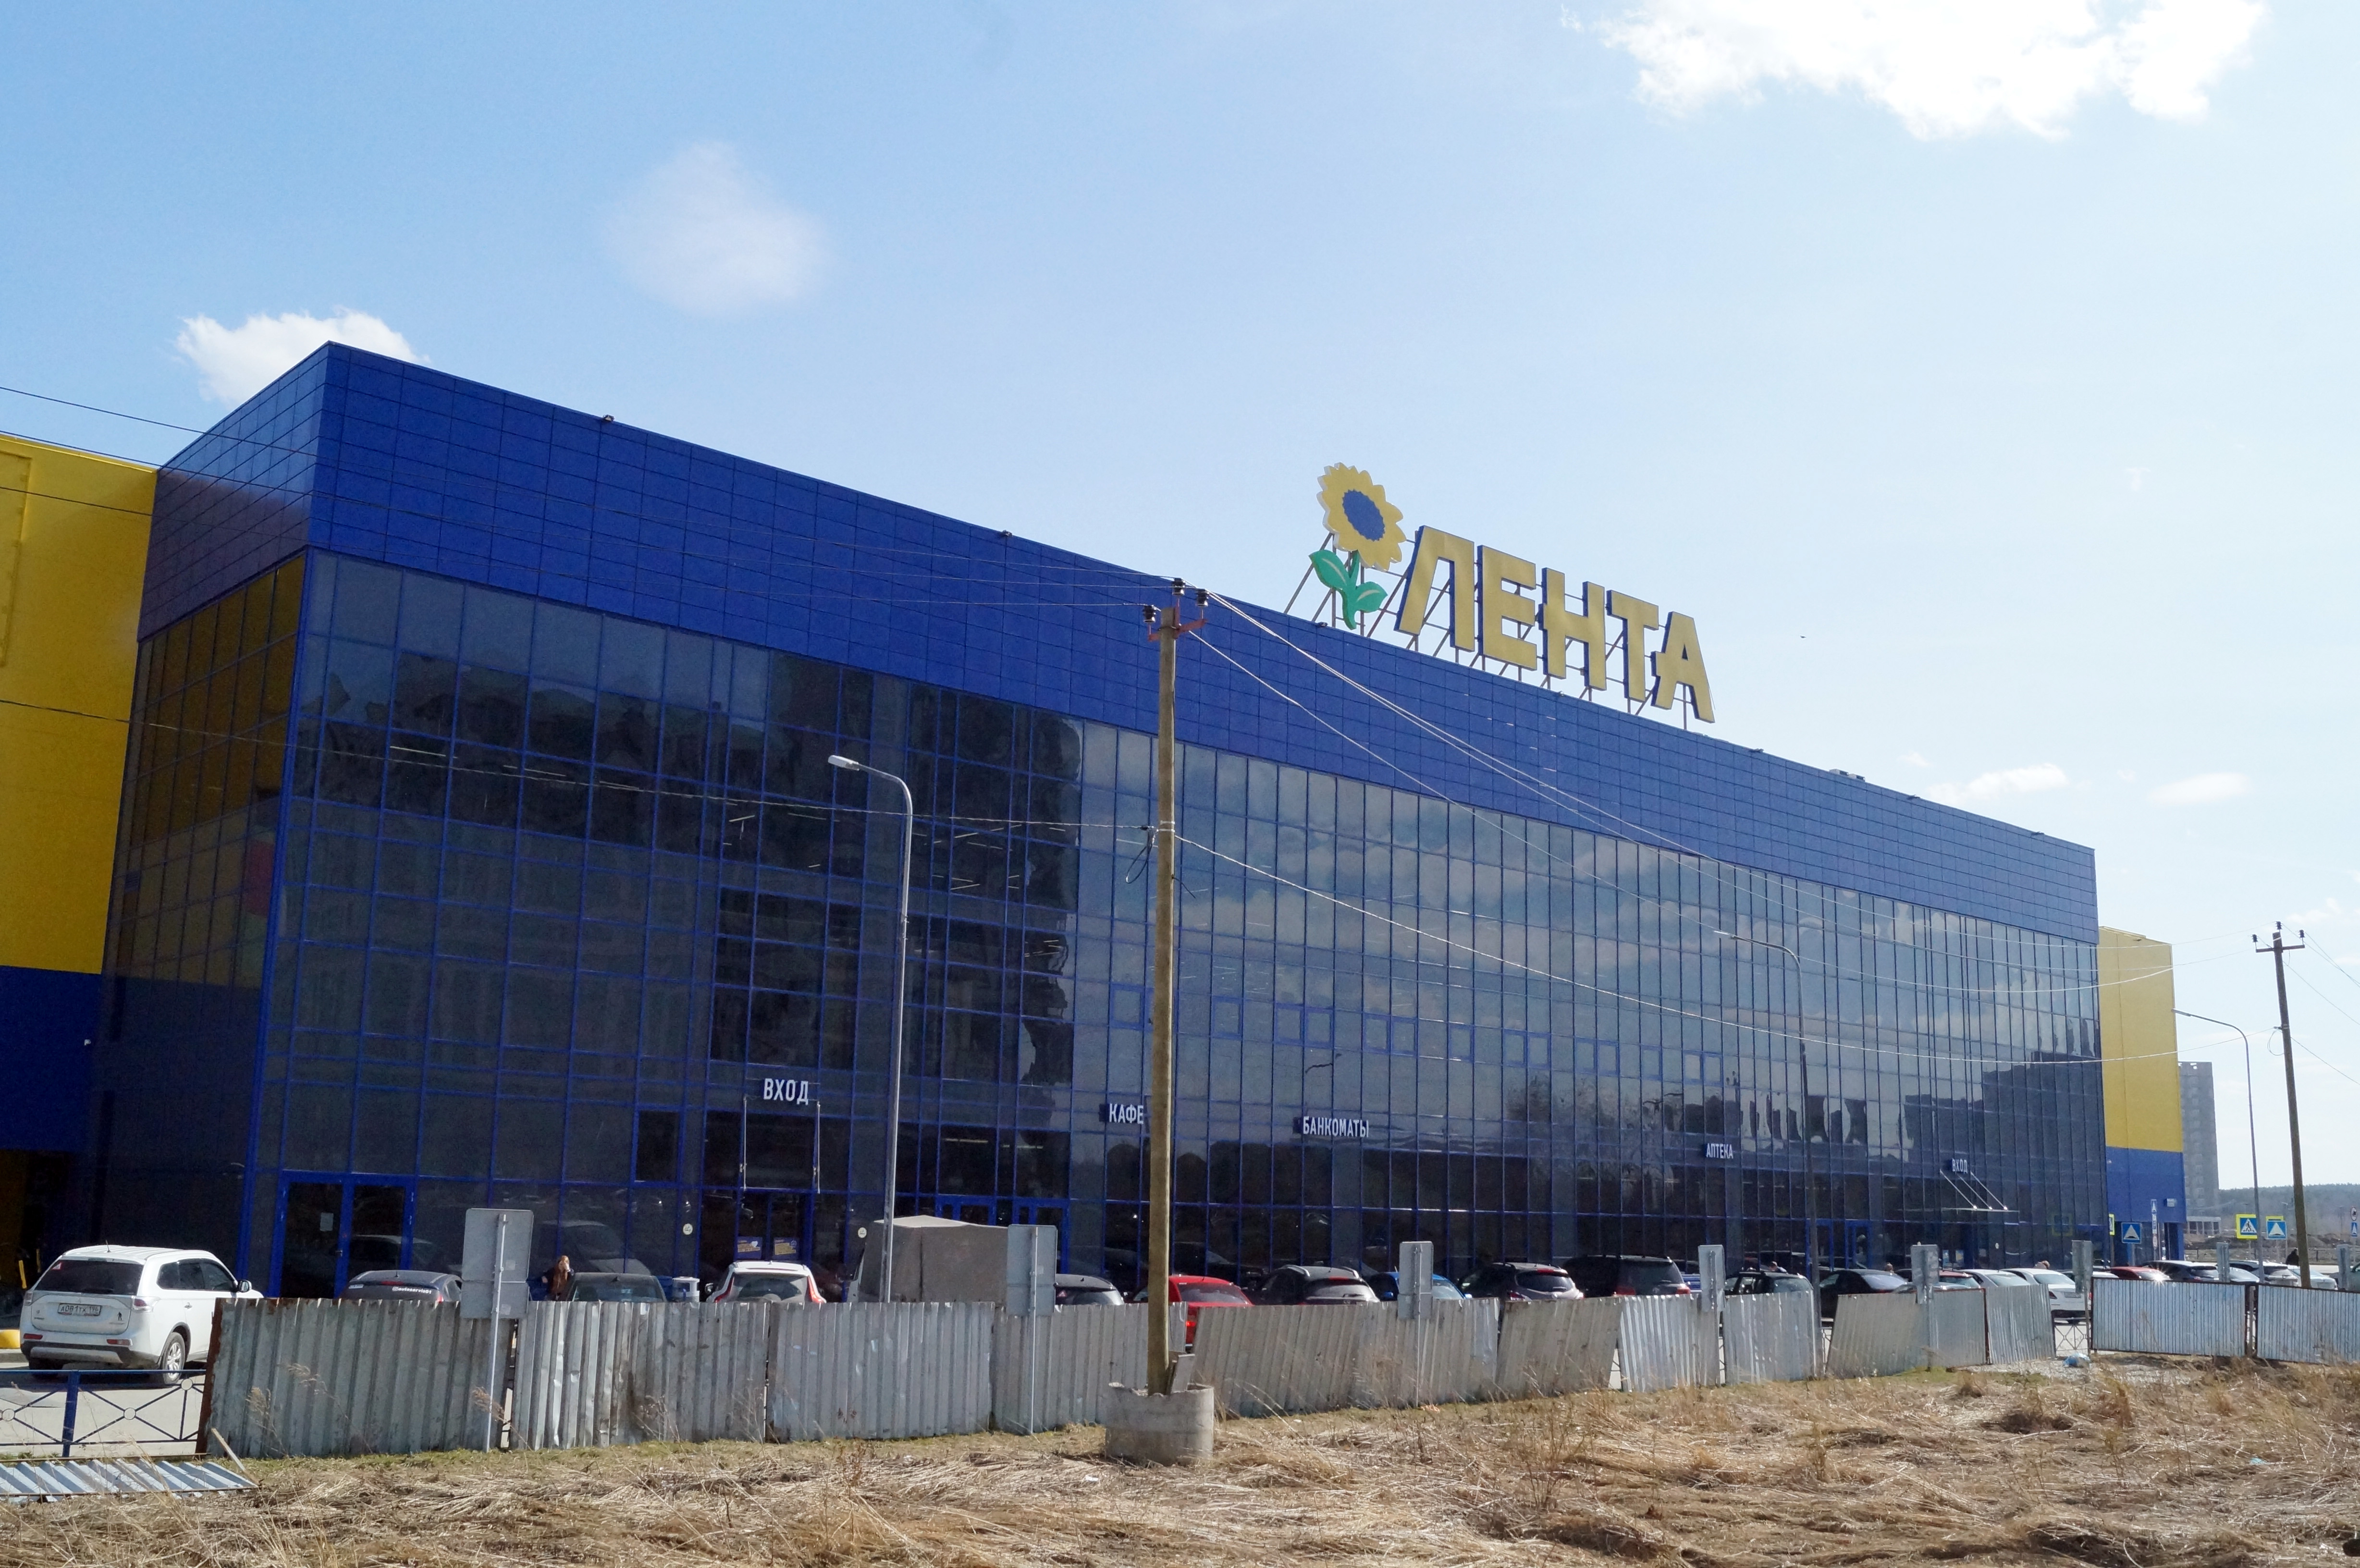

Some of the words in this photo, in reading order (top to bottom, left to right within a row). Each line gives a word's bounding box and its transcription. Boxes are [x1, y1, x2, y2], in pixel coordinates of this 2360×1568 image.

[1394, 525, 1715, 723] ЛЕНТА
[763, 1078, 809, 1105] ВХОД
[1109, 1103, 1144, 1124] КАФЕ
[1303, 1115, 1369, 1138] БАНКОМАТЫ
[1706, 1143, 1733, 1159] АПТЕКА
[1952, 1158, 1968, 1174] ВХОД
